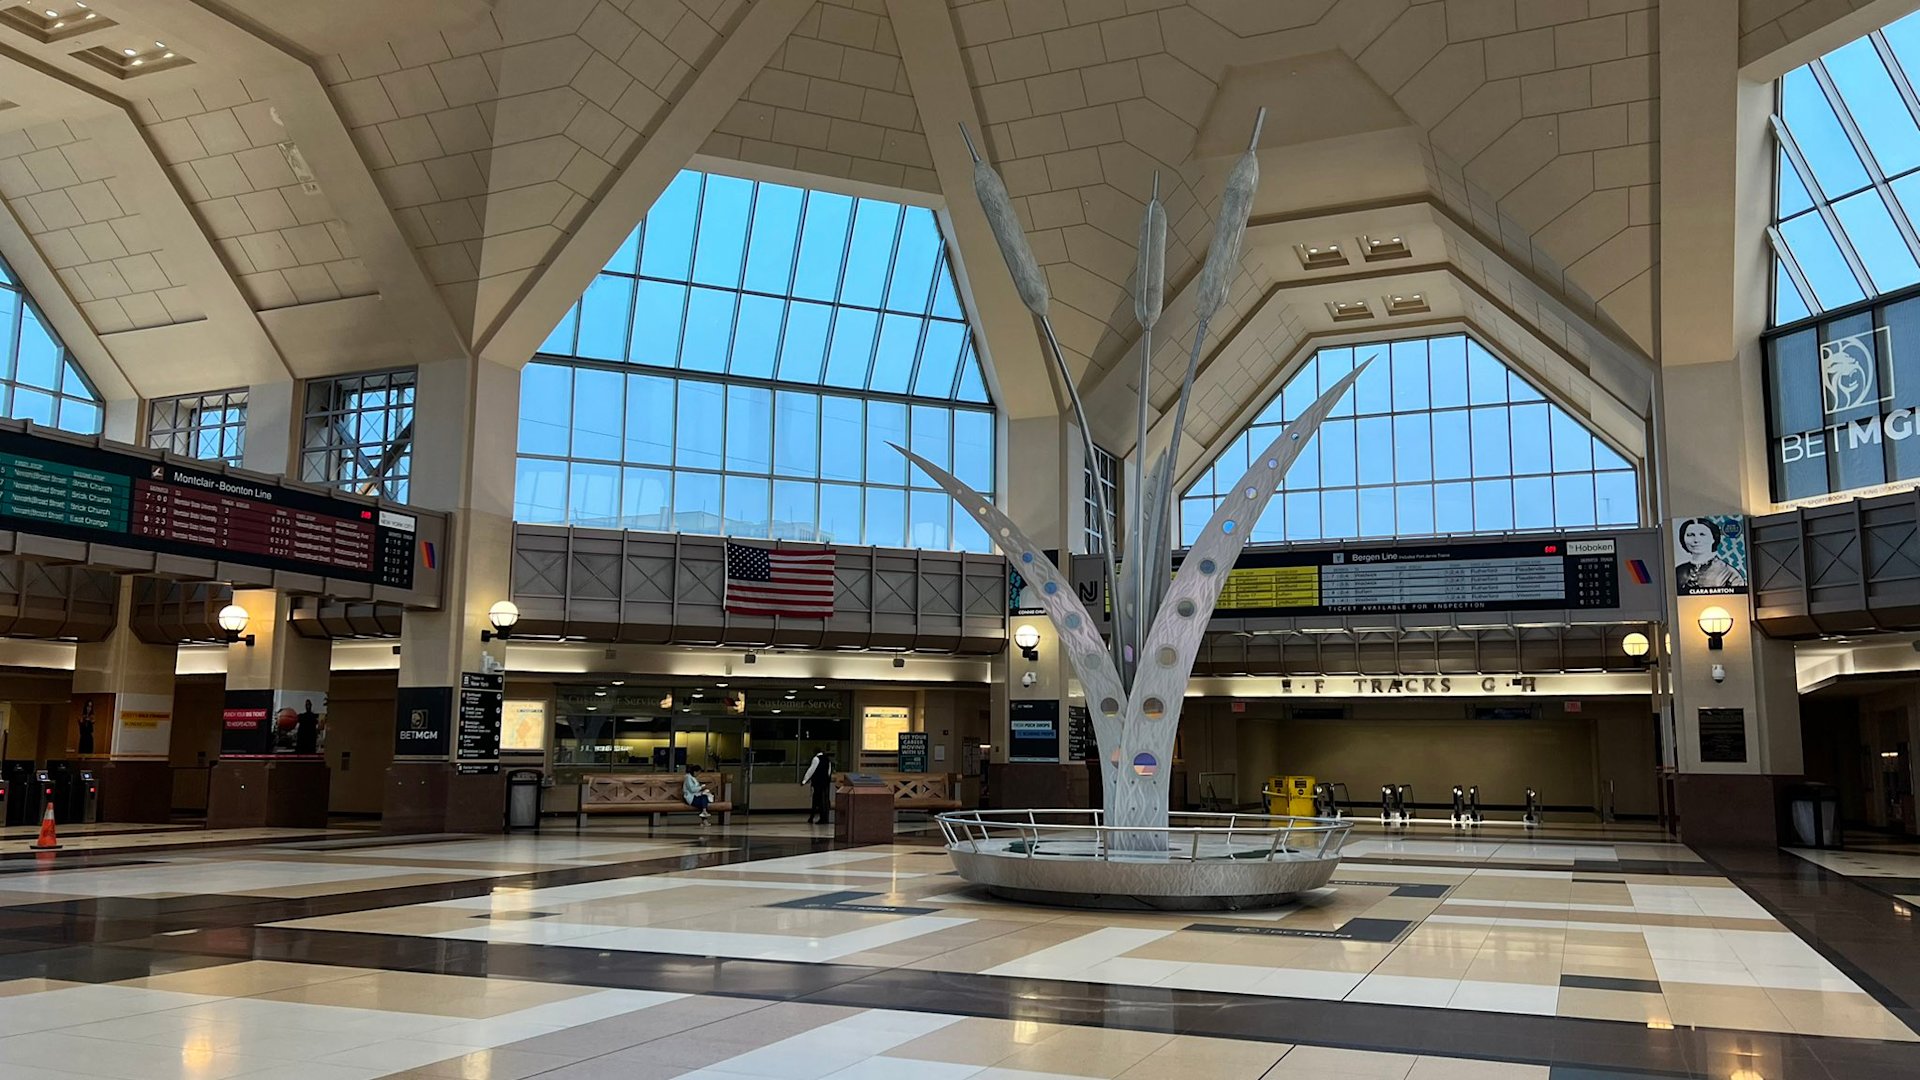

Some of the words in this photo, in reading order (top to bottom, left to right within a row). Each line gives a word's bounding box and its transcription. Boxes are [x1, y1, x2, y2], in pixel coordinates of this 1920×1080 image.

[1781, 407, 1920, 463] BETMG
[72, 480, 89, 488] Brick
[89, 481, 113, 493] Church
[71, 491, 88, 500] Brick
[88, 493, 112, 504] Church
[255, 488, 272, 500] Line
[1808, 494, 1848, 505] SPORTSBOOKS
[70, 503, 87, 512] Brick
[87, 505, 110, 516] Church
[70, 515, 84, 523] East
[85, 517, 109, 527] Orange
[1575, 543, 1613, 552] Hoboken
[1352, 554, 1380, 563] Bergen
[1381, 552, 1398, 560] Line
[1314, 679, 1325, 694] F
[1353, 677, 1451, 694] TRACKS
[1481, 677, 1496, 693] G
[1521, 677, 1536, 693] H
[568, 695, 623, 705] Customr
[758, 698, 805, 708] Customer
[808, 699, 842, 710] Service
[400, 731, 438, 740] BETMGM
